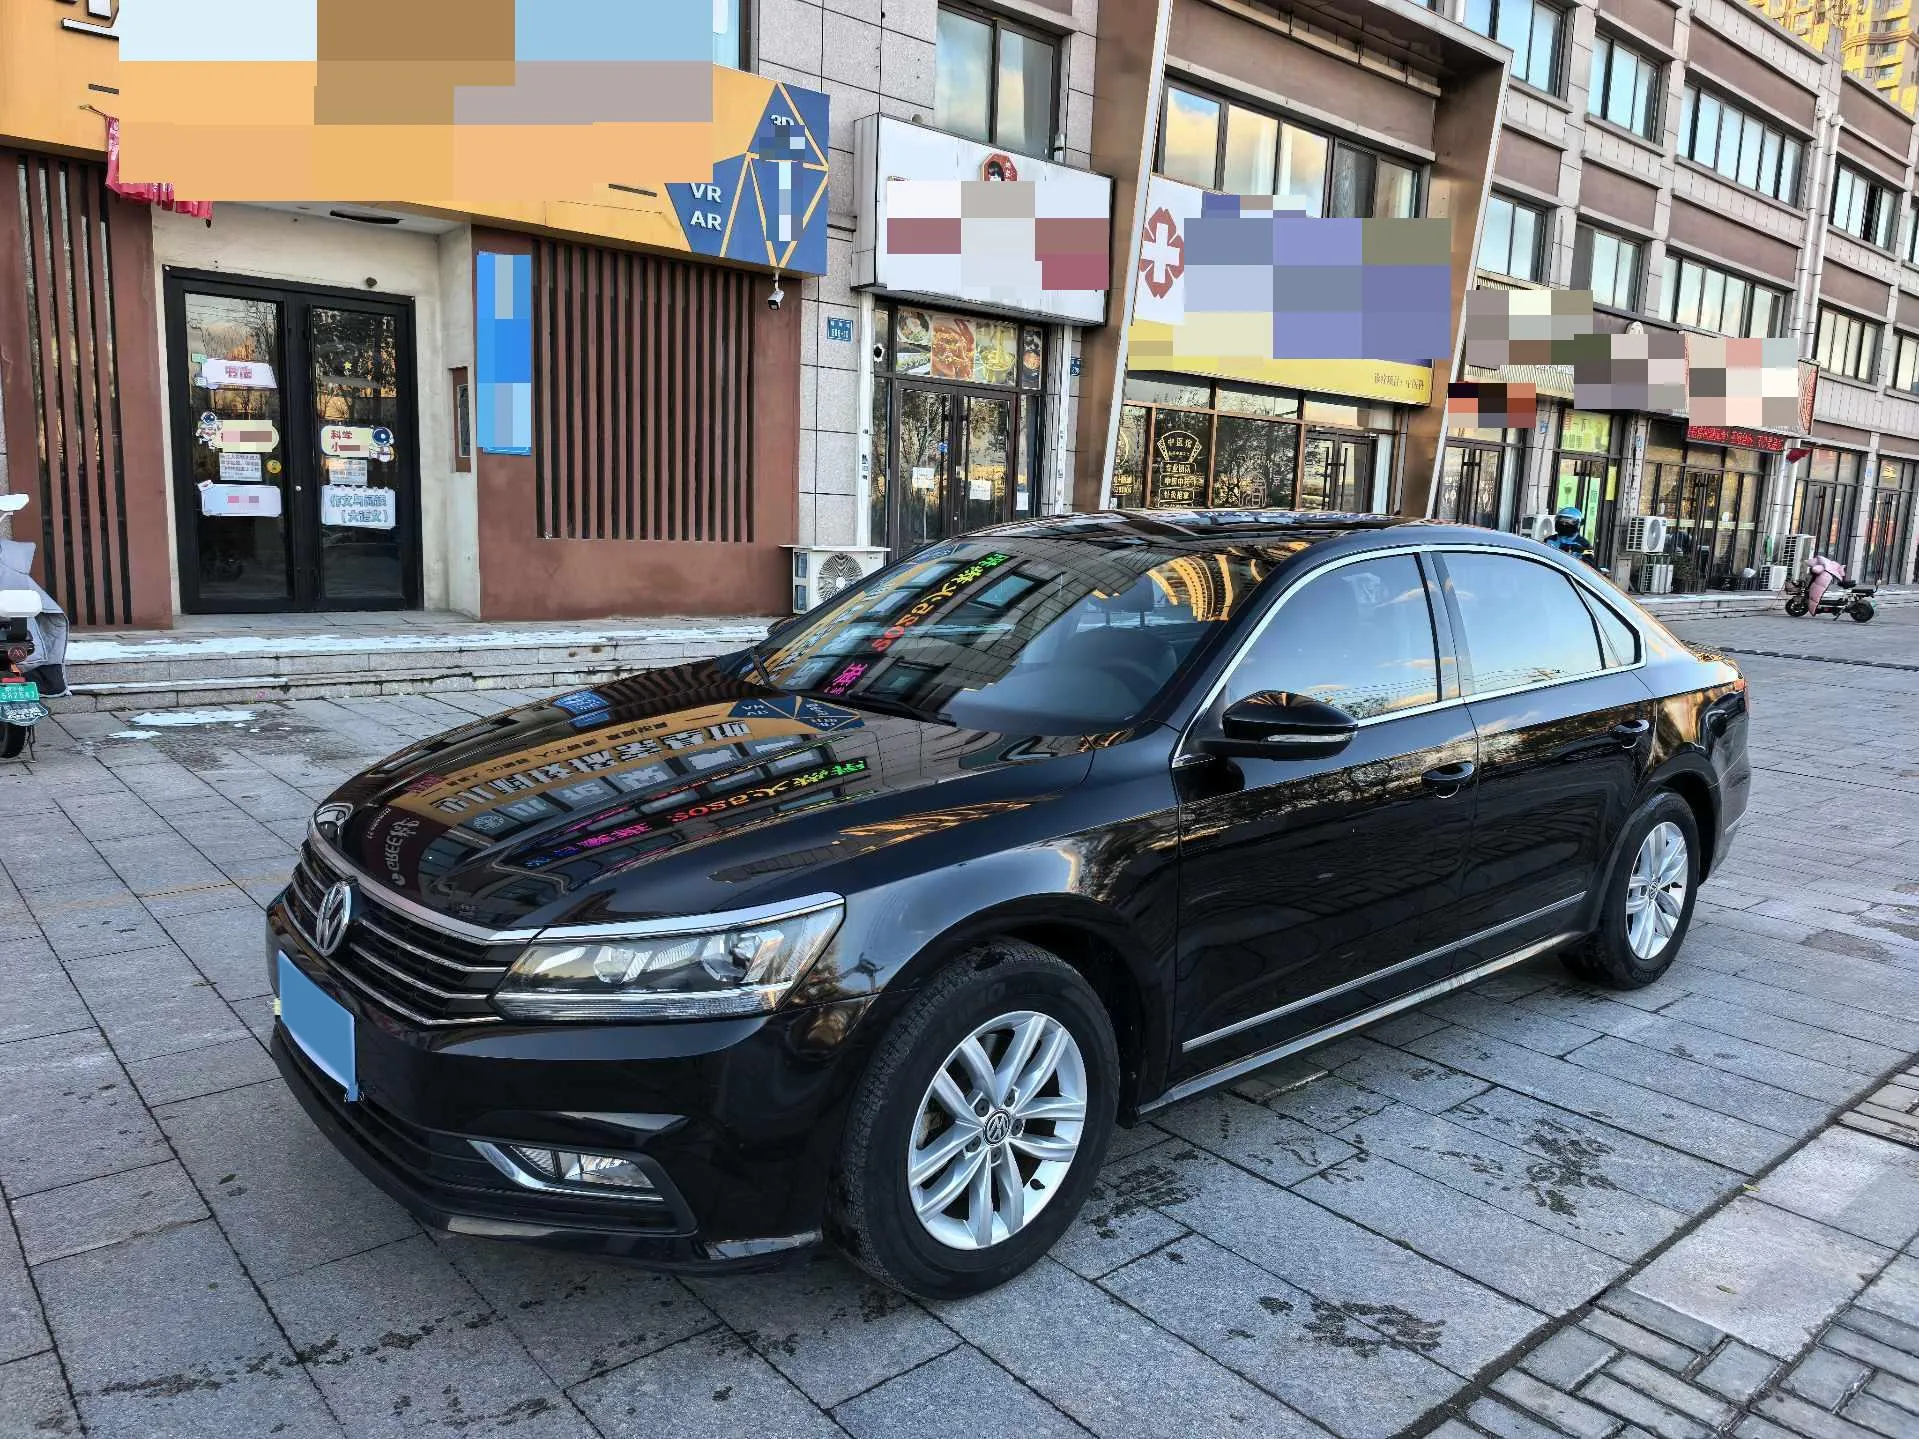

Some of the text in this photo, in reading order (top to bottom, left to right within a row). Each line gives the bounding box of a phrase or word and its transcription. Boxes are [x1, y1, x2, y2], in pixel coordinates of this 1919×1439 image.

[690, 182, 722, 203] VR
[690, 210, 723, 231] AR
[331, 429, 353, 440] 科学
